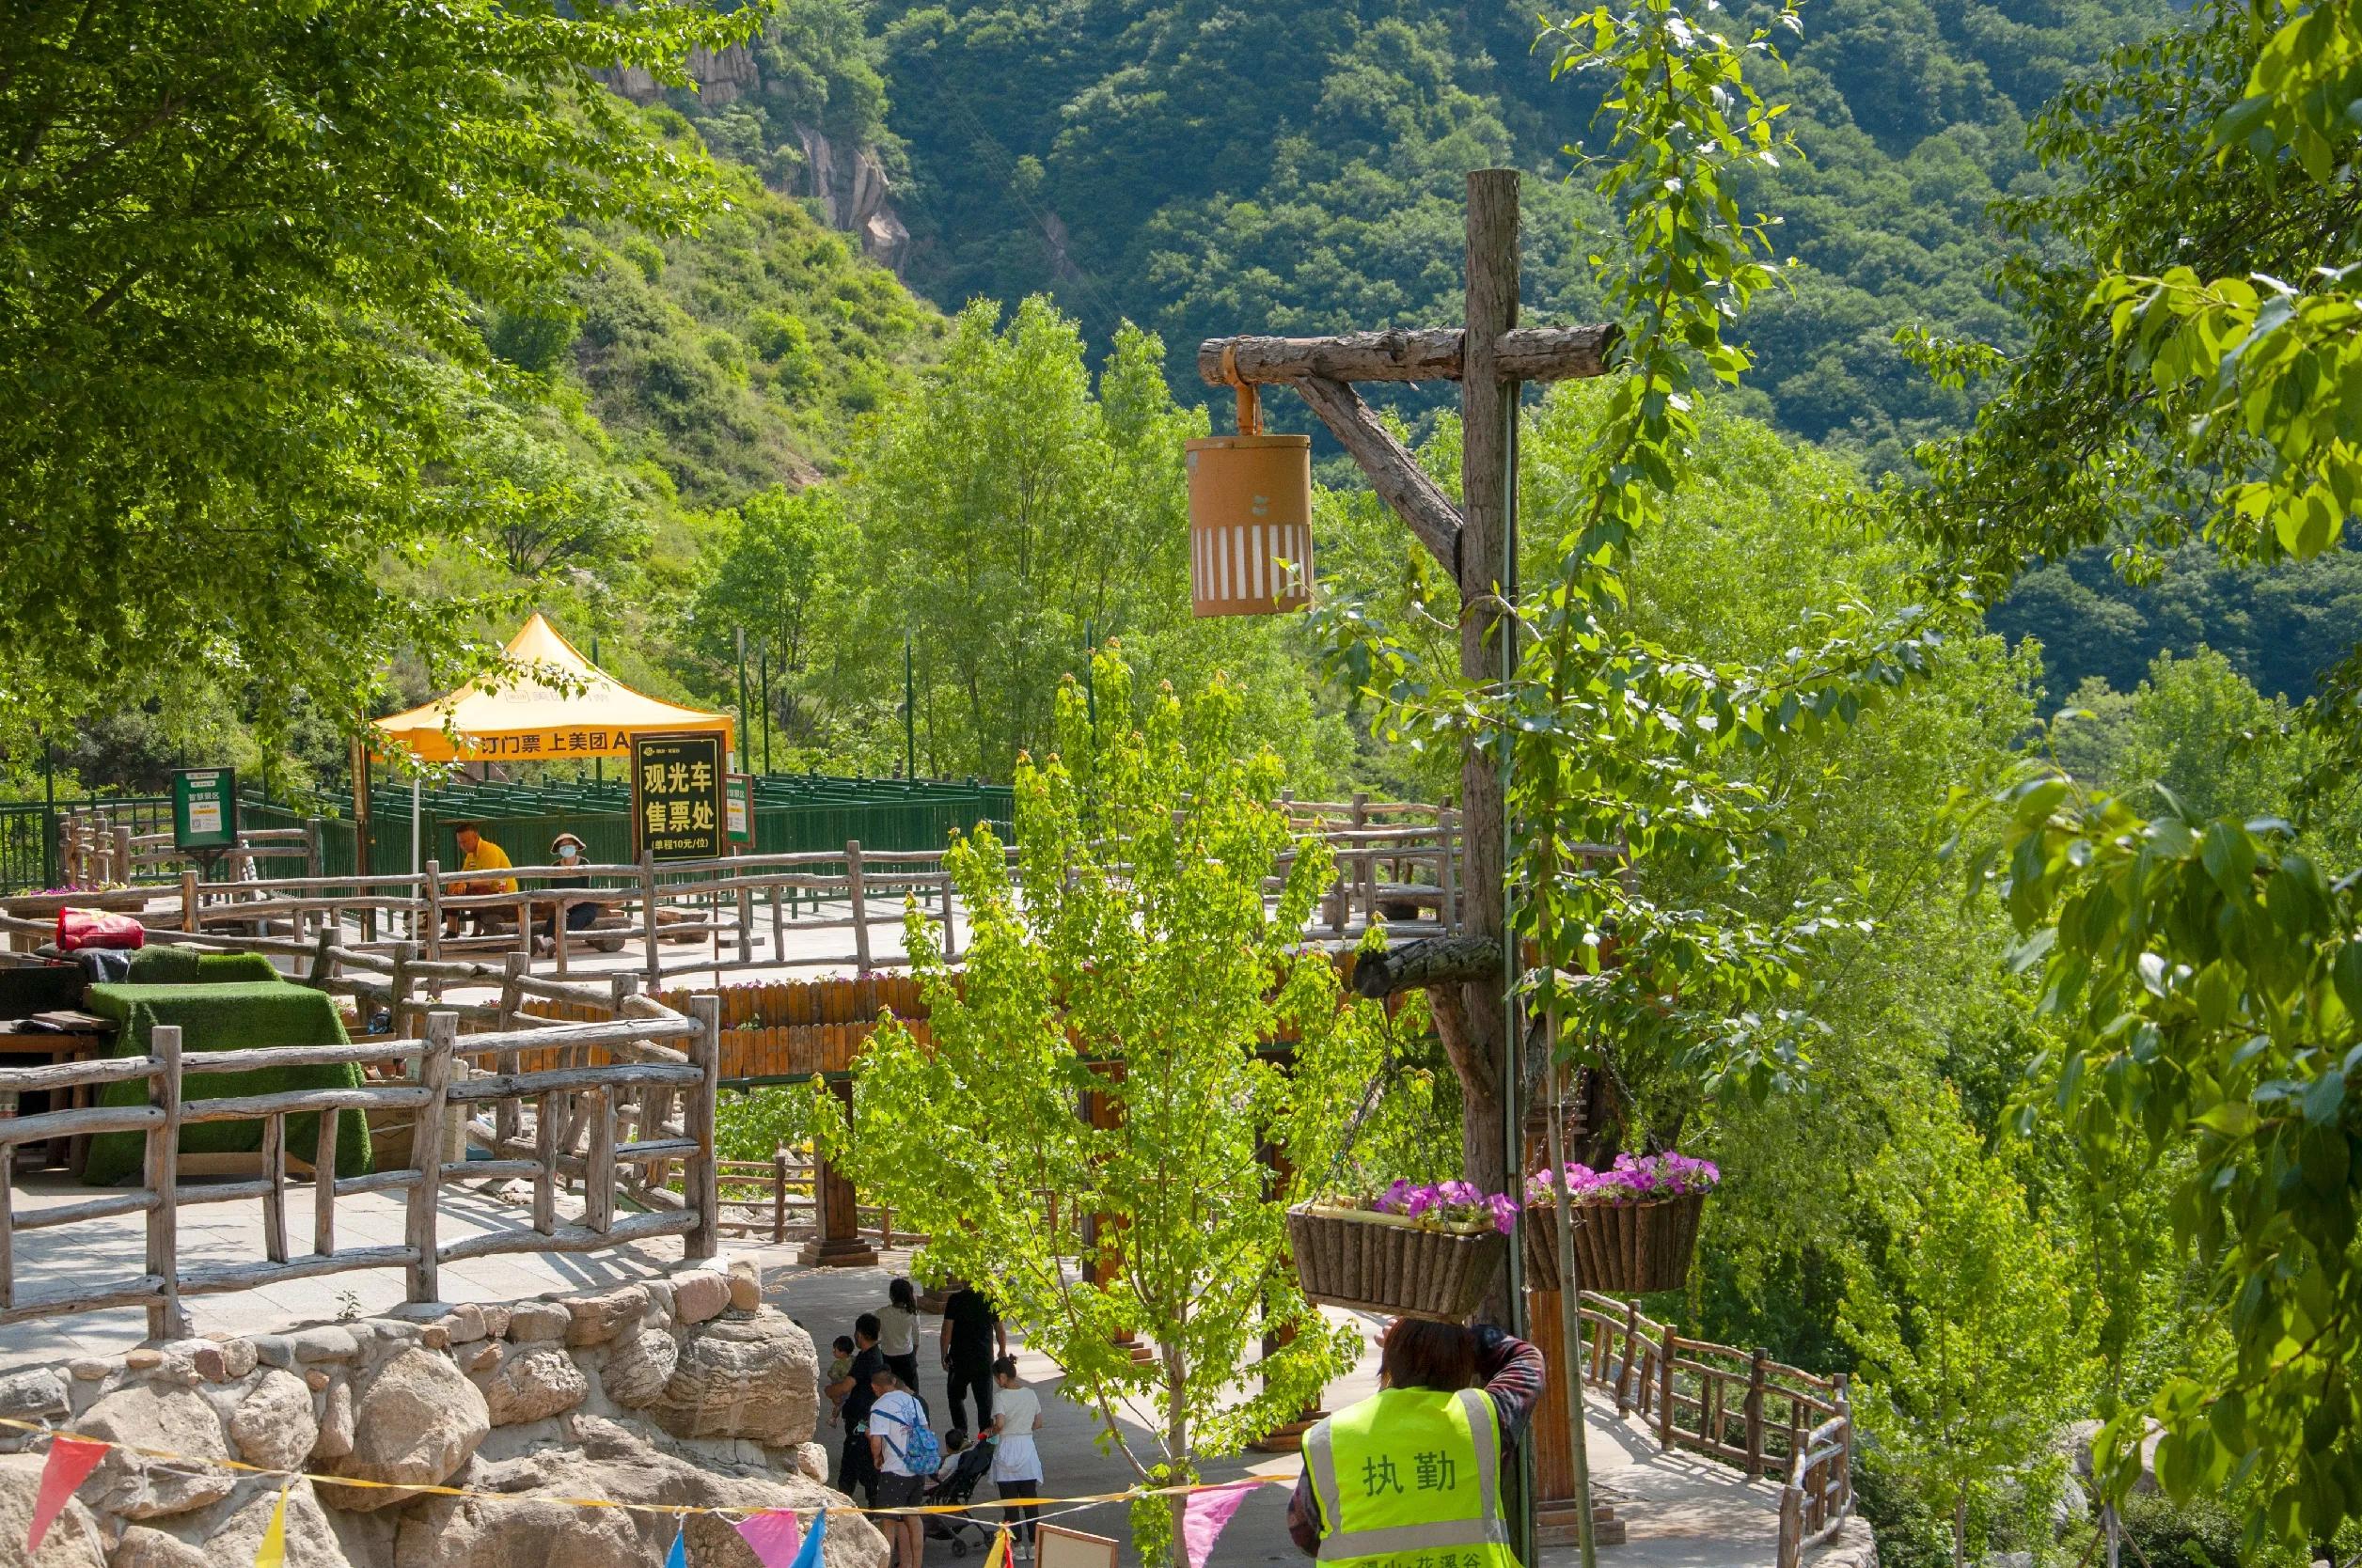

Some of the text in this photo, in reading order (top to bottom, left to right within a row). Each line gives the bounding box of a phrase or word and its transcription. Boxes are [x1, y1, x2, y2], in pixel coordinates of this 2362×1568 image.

[481, 734, 542, 754] 订门票
[643, 760, 713, 793] 观光车
[645, 800, 715, 834] 售票处
[652, 839, 709, 851] (单程10元/位)
[1362, 1450, 1456, 1497] 执勤
